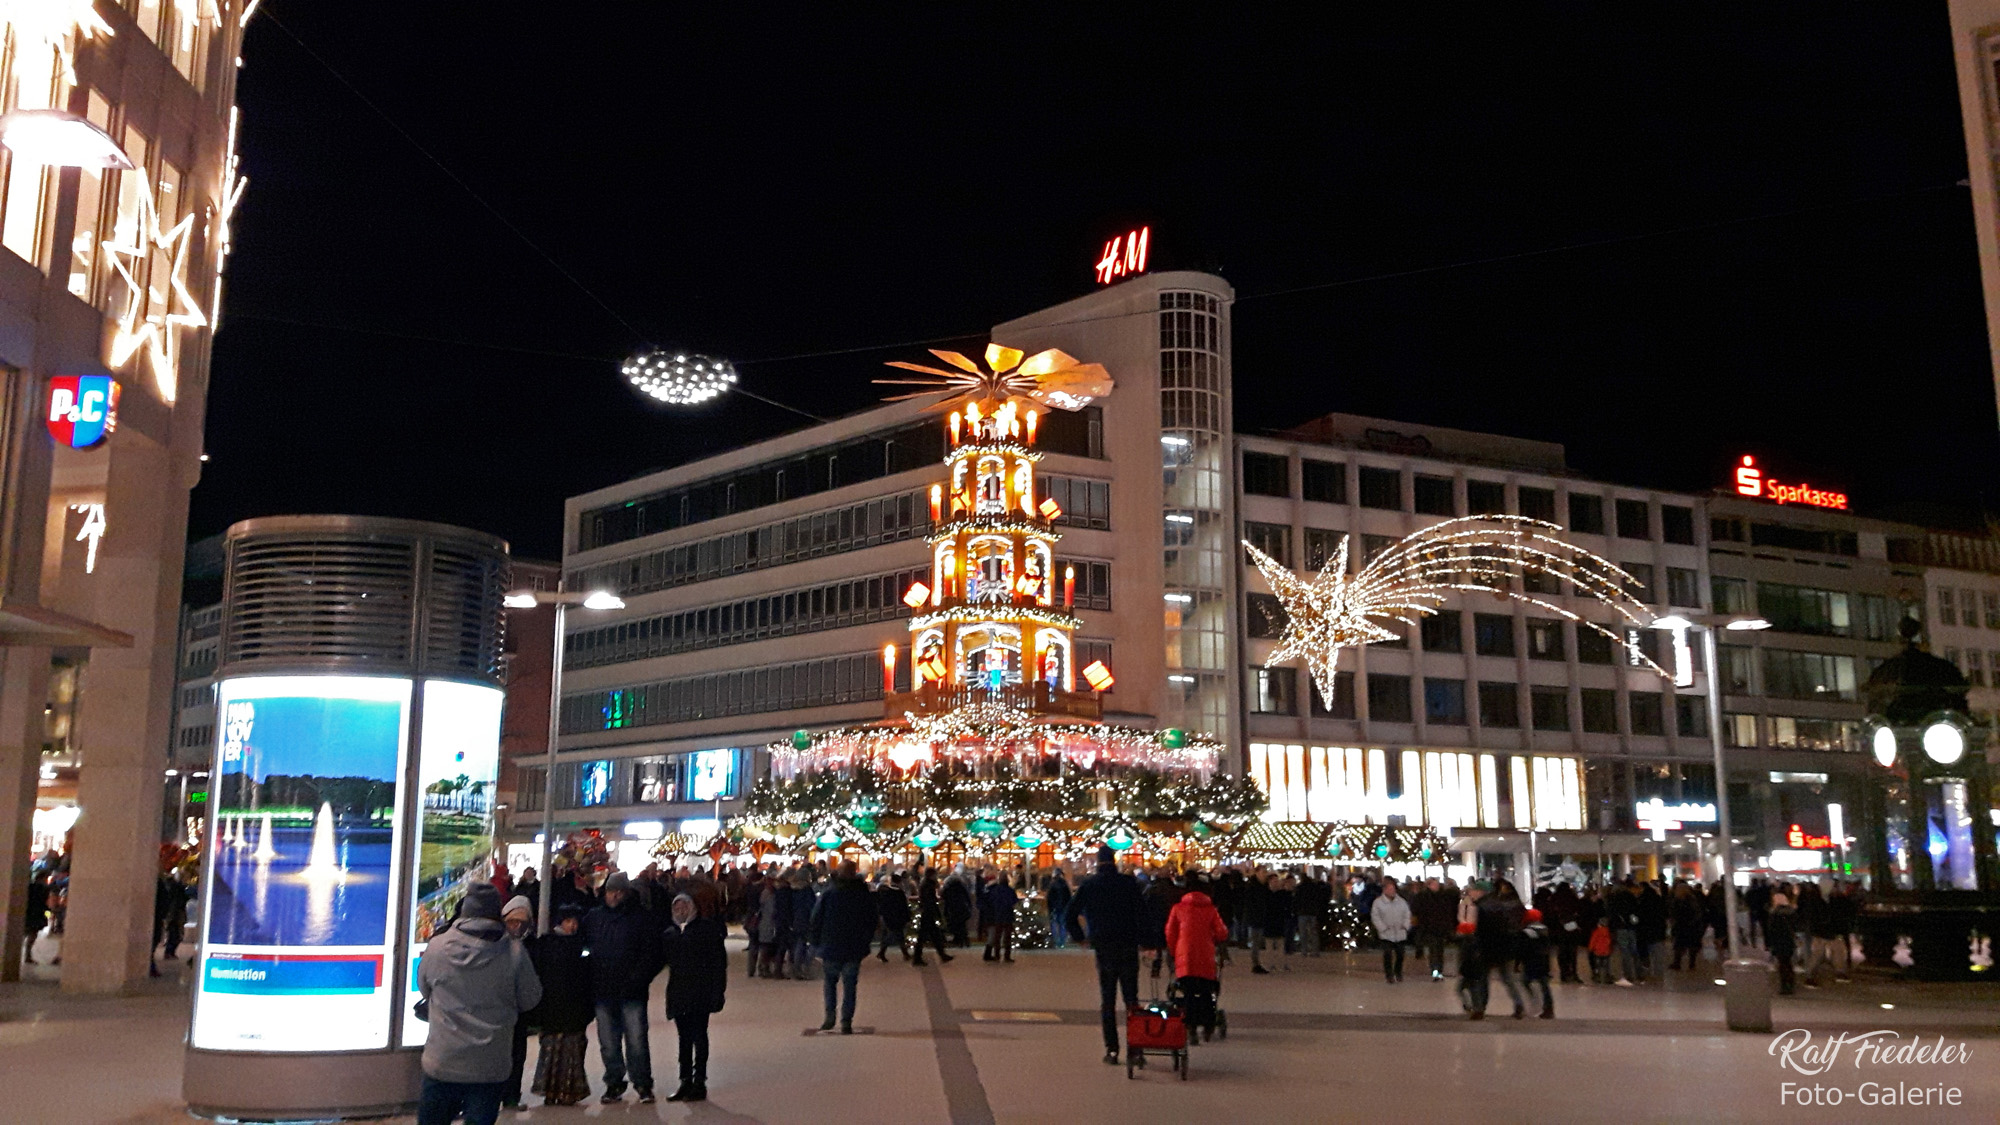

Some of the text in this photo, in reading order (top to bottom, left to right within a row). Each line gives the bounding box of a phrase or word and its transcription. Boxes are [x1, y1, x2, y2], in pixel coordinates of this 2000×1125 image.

[1096, 226, 1149, 285] H&M
[50, 388, 104, 423] P&C
[1767, 478, 1848, 510] Sparkasse
